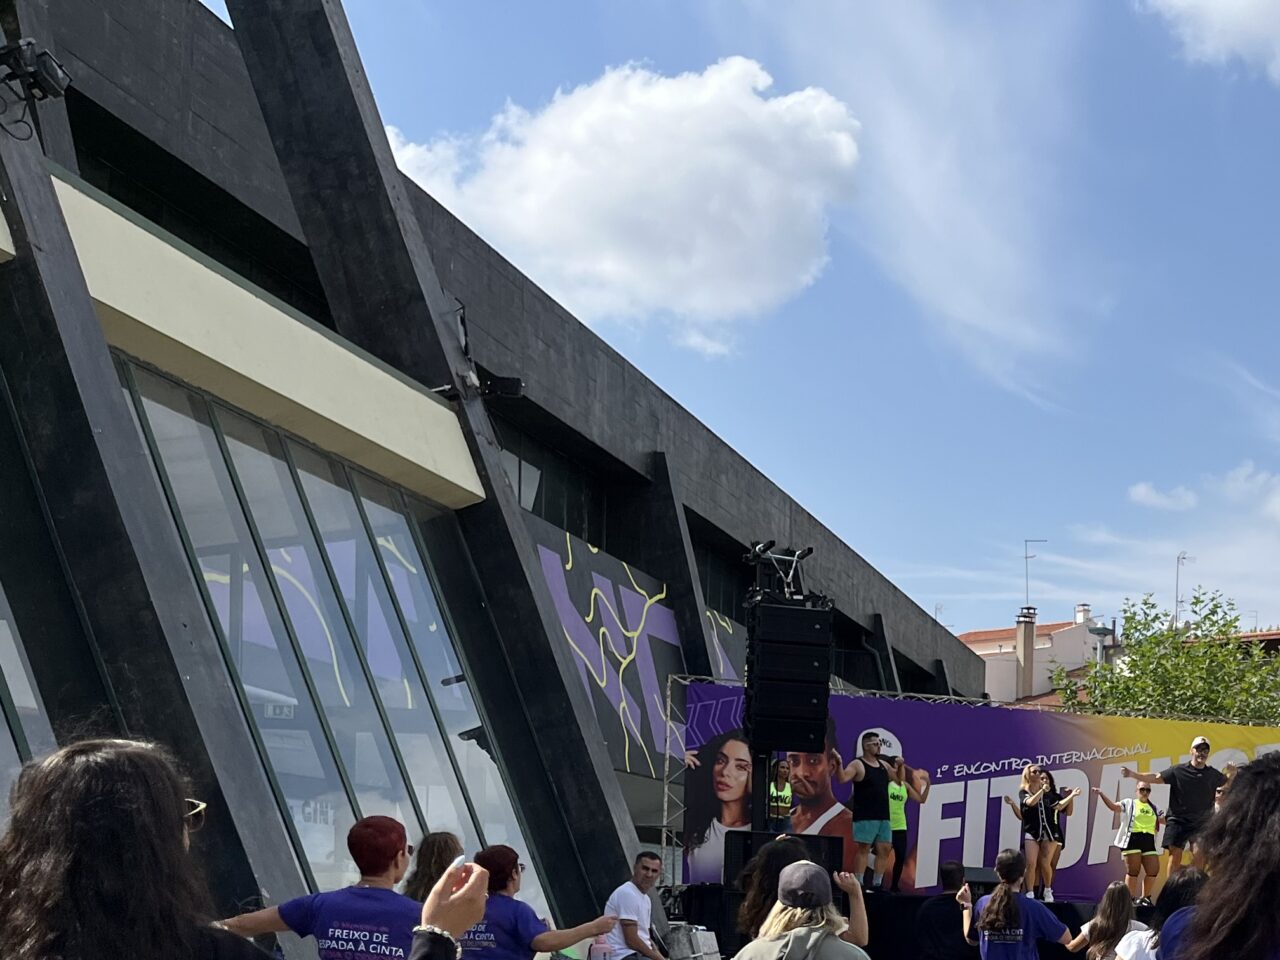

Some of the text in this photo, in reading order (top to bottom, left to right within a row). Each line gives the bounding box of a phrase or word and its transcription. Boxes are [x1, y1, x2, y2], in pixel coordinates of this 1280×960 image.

[953, 757, 1031, 777] ENCONTRO
[1035, 743, 1152, 766] INTERNACIONAL
[328, 928, 389, 944] FREIXO DE
[358, 941, 366, 952] À
[369, 944, 405, 958] CINTA
